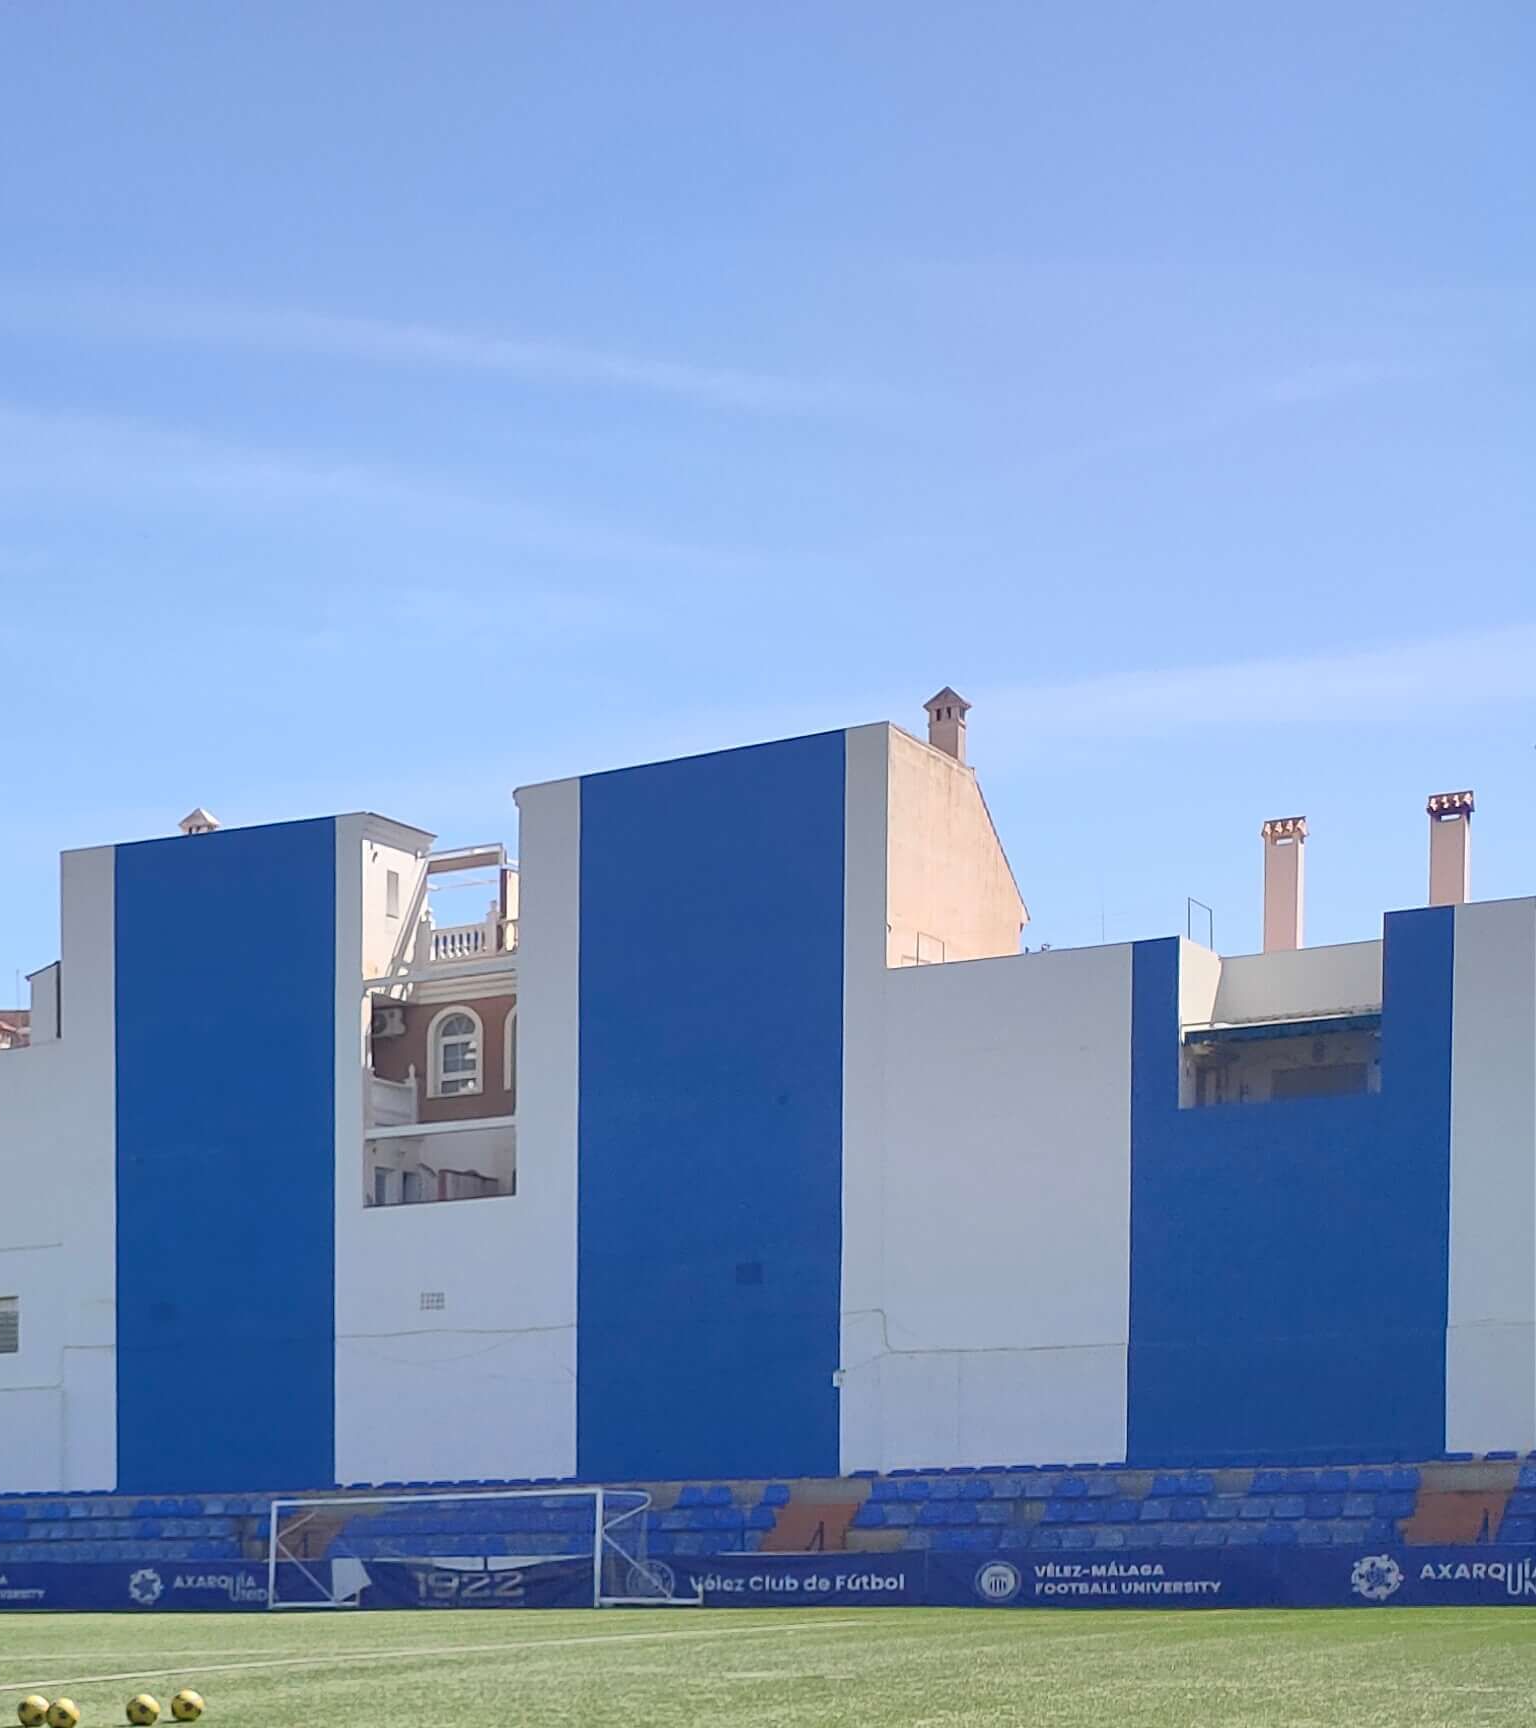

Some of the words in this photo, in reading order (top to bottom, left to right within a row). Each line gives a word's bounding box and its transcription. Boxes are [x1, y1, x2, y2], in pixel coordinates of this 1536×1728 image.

[1034, 1561, 1165, 1578] VÉLEZ-MÁLAGA
[1419, 1557, 1536, 1596] AXARQUÍ
[415, 1570, 525, 1599] 1922
[749, 1574, 799, 1591] Club
[803, 1574, 831, 1591] de
[835, 1573, 905, 1591] Fútbol
[1035, 1581, 1118, 1595] FOOTBALL
[1121, 1581, 1221, 1594] UNIVERSITY
